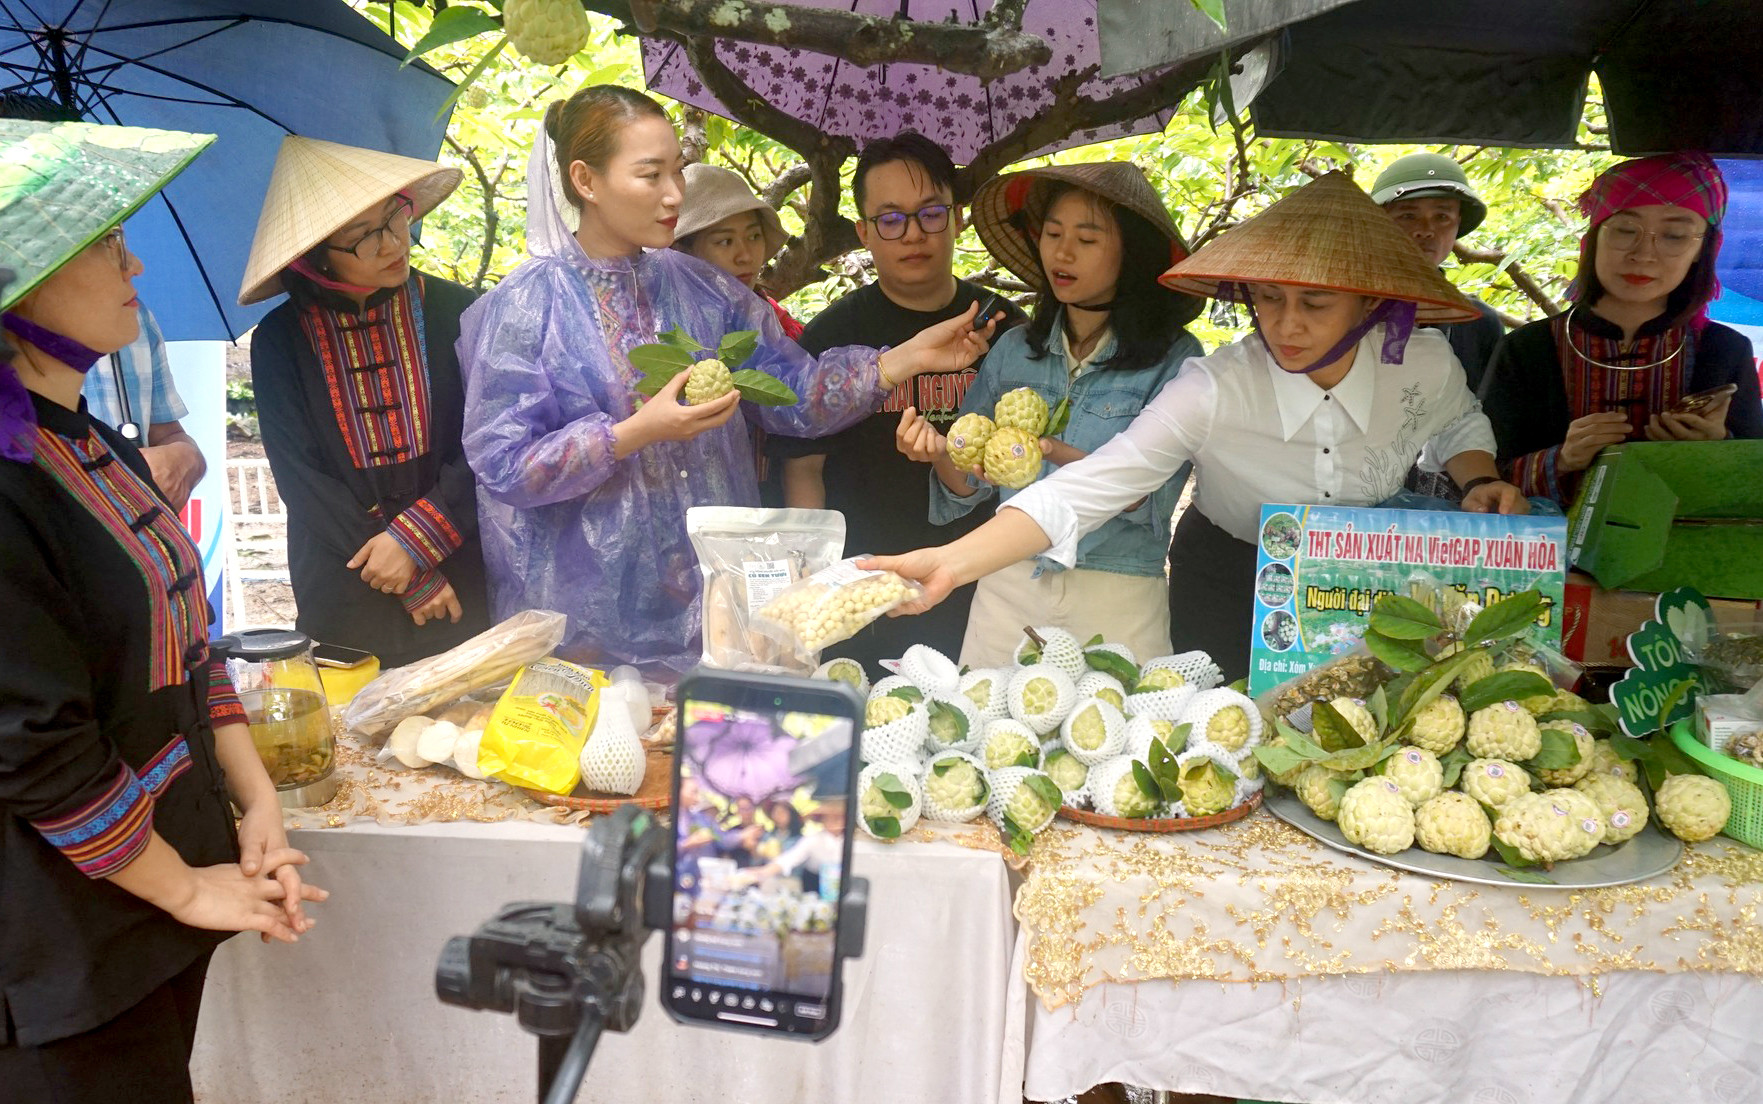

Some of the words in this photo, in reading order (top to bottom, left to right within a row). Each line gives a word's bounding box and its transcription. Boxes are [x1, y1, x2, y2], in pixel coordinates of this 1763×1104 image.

[1308, 530, 1332, 558] THT
[1334, 523, 1363, 560] SẢN
[1365, 524, 1402, 562] XUẤT
[1404, 535, 1424, 563] NA
[1428, 536, 1480, 566] VietGAP
[1485, 535, 1524, 569] XUÂN
[1528, 535, 1557, 571] HÒA
[1307, 586, 1346, 611] Người
[1348, 589, 1371, 616] đại
[1258, 658, 1272, 675] Địa
[1289, 660, 1306, 674] Xóm
[1640, 634, 1682, 671] TÔI
